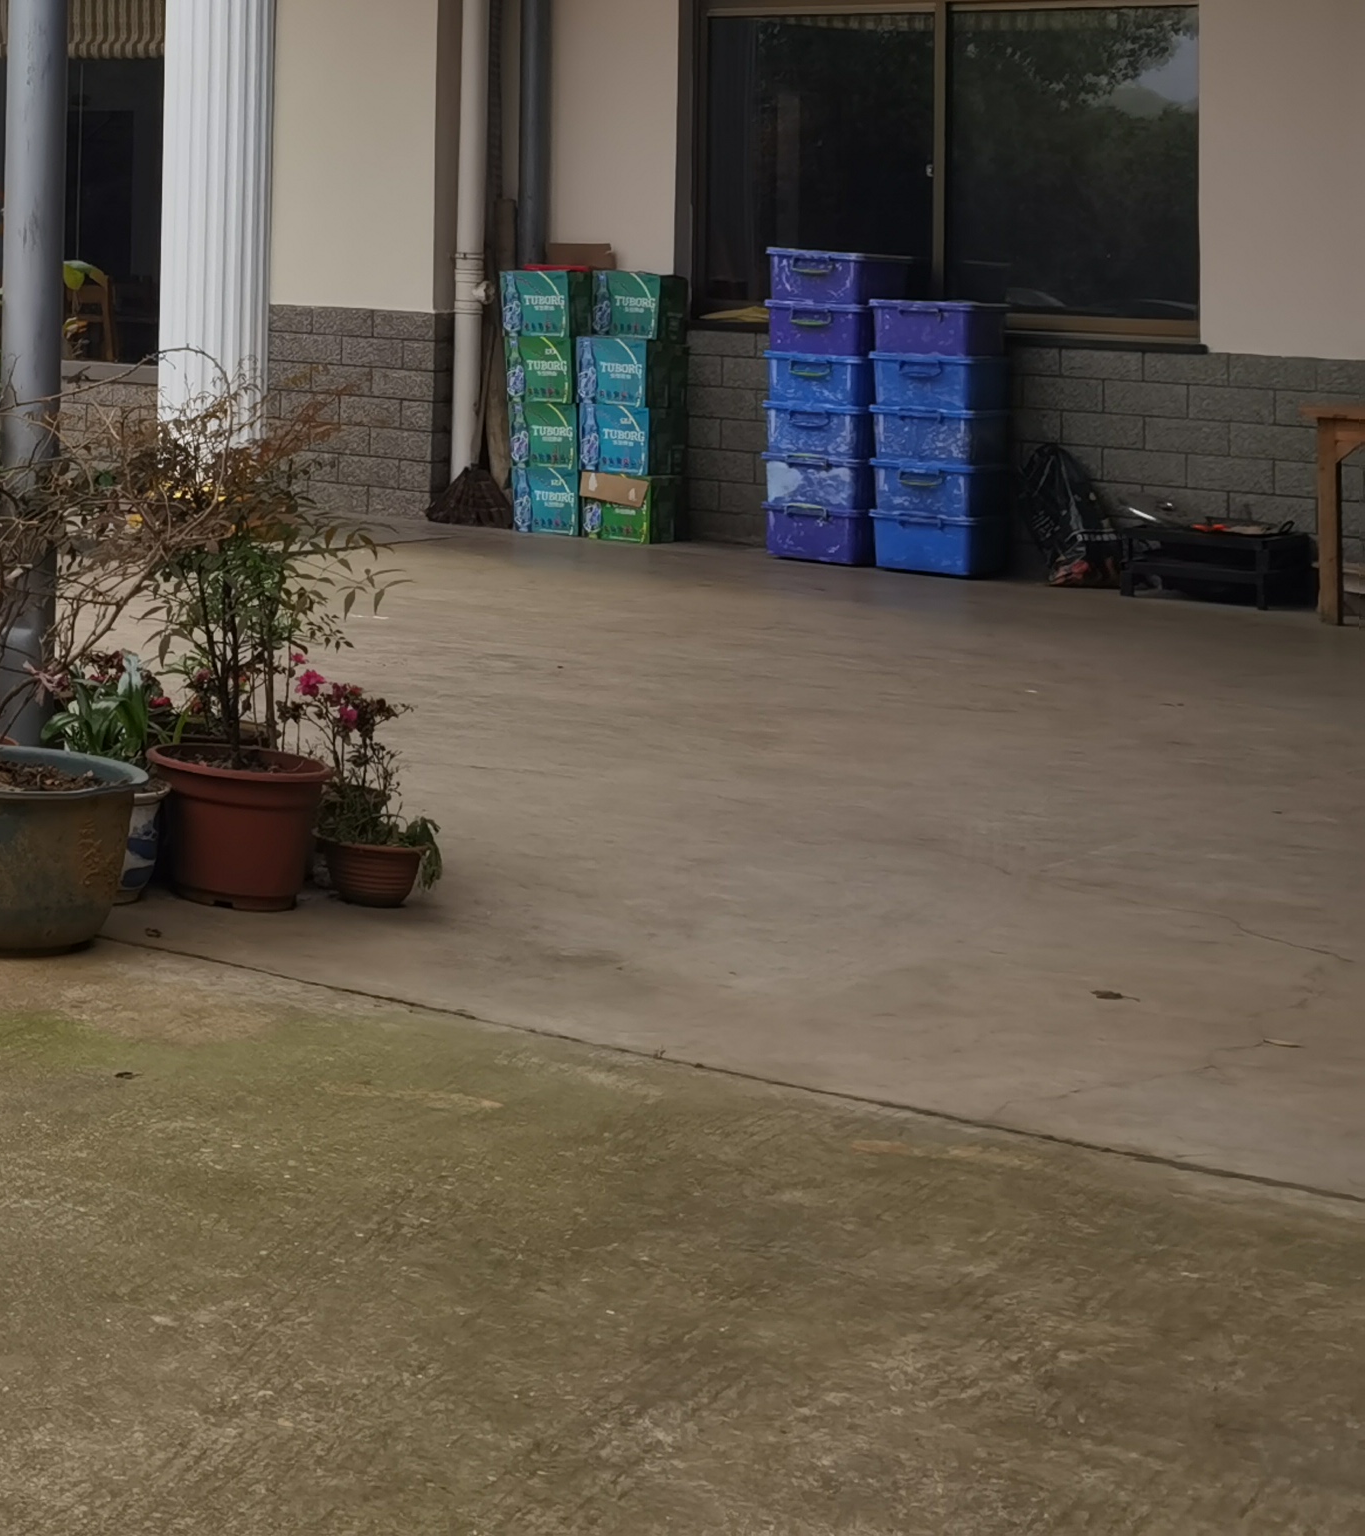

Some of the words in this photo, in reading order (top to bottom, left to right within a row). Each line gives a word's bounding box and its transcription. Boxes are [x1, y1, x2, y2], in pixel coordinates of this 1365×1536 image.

[523, 295, 565, 307] TUBORG
[614, 296, 656, 308] TUBORG
[526, 360, 567, 372] TUBORG
[599, 361, 642, 375] TUBORG
[531, 425, 573, 438] TUBORG
[602, 428, 646, 442] TUBORG
[534, 490, 574, 504] TUBORG
